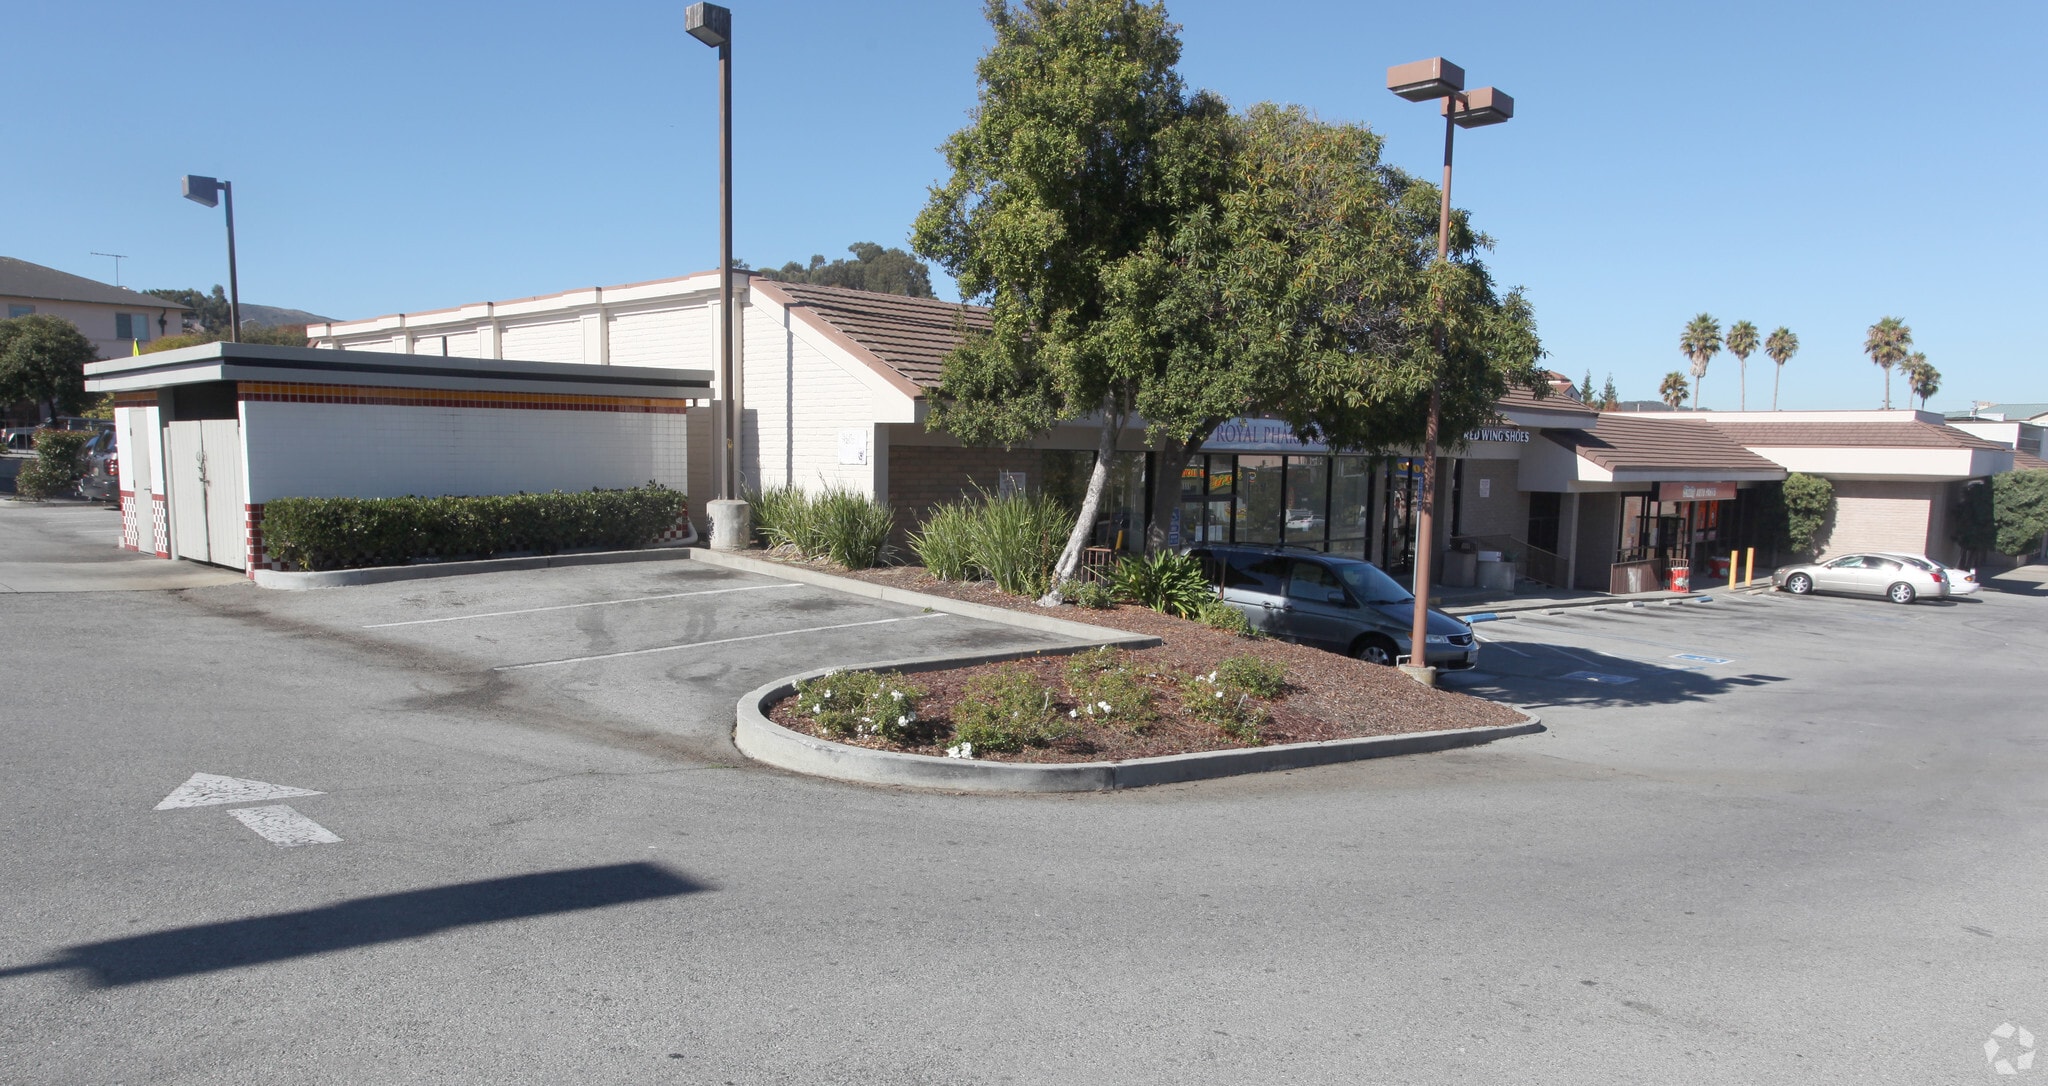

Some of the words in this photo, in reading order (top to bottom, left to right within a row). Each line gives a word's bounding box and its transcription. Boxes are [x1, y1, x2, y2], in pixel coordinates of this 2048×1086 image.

[1216, 424, 1258, 443] ROYAL
[1463, 429, 1480, 440] RED
[1481, 429, 1503, 442] WING
[1504, 430, 1530, 443] SHOES
